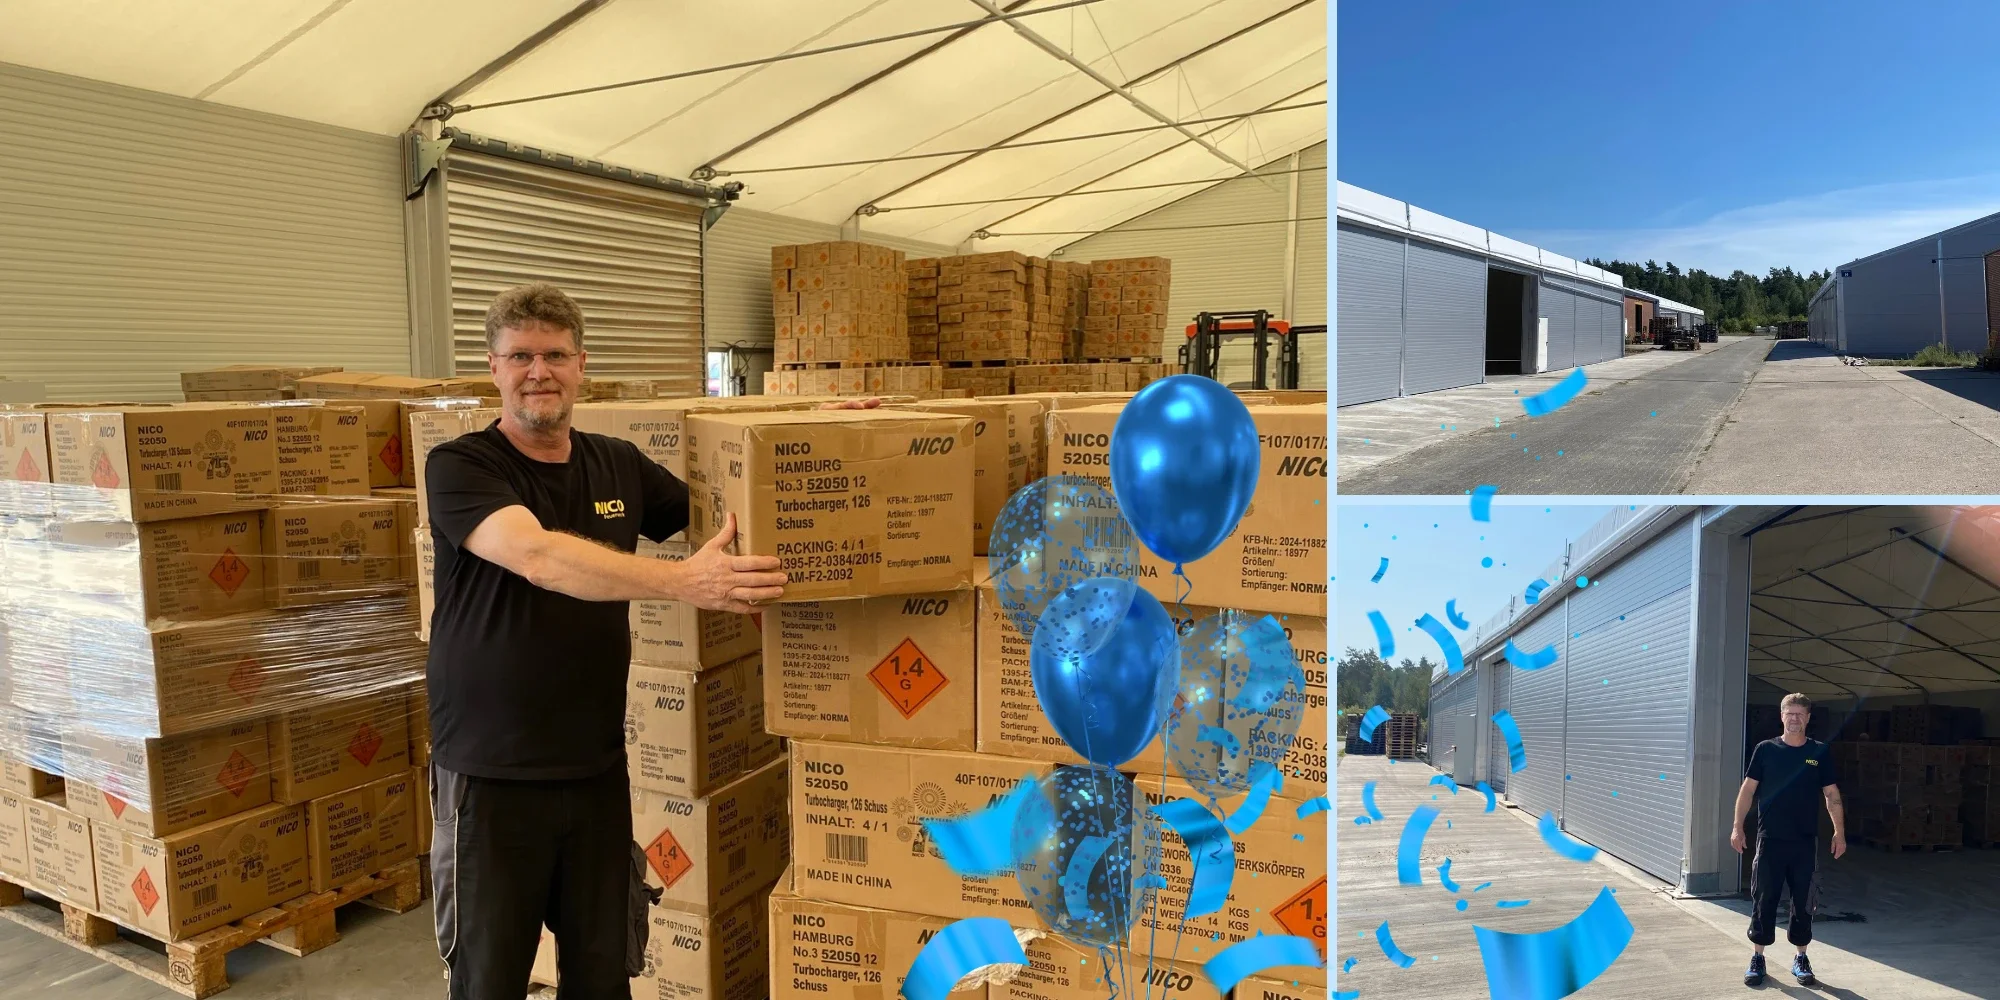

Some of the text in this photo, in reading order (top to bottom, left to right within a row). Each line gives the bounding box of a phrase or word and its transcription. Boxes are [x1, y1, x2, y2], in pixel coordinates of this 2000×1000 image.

[226, 420, 268, 428] 40F107/017/24
[337, 415, 358, 425] NICO
[21, 423, 37, 434] NICO
[99, 426, 116, 438] NICO
[138, 425, 164, 435] NICO
[277, 425, 308, 433] HAMBURG
[629, 422, 680, 432] 40F107/017/24
[138, 437, 167, 446] 52050
[244, 430, 268, 442] NICO
[648, 434, 679, 448] NICO
[1063, 433, 1110, 448] NICO
[775, 441, 812, 456] NICO
[907, 436, 954, 456] NICO
[141, 461, 183, 471] INHALT: 4
[729, 459, 742, 479] NICO
[775, 459, 842, 474] HAMBURG
[775, 475, 866, 492] No.3 52050 12
[144, 498, 198, 510] MADE IN CHINA
[775, 494, 870, 513] Turbocharger, 126
[886, 493, 954, 505] KFB-Nr.: 2024-1188277
[594, 499, 625, 515] NICO
[918, 508, 936, 518] 18977
[223, 522, 247, 535] NICO
[285, 518, 306, 527] NICO
[373, 519, 393, 530] NICO
[776, 516, 815, 531] Schuss
[886, 521, 912, 530] Größen/
[285, 528, 309, 536] 52050
[886, 532, 921, 541] Sortierung:
[776, 538, 864, 555] PACKING: 4 / 1
[1243, 535, 1278, 546] KFB-Nr.:
[1242, 546, 1309, 558] Artikelnr.: 18977
[220, 560, 239, 574] 1.4
[886, 555, 952, 571] Empfänger: NORMA
[1242, 556, 1275, 567] Größen/
[1059, 559, 1158, 578] MADE IN CHINA
[1241, 567, 1288, 581] Sortierung:
[787, 569, 853, 584] AM-F2-2092
[1241, 580, 1288, 593] Empfänger:
[902, 598, 949, 616] NICO
[781, 610, 798, 619] No.3
[799, 611, 823, 619] 52050
[993, 612, 999, 621] 9
[781, 621, 837, 632] Turbocharger, 126
[159, 633, 182, 644] NICO
[781, 631, 804, 640] Schuss
[665, 640, 684, 648] NORMA
[782, 642, 821, 651] PACKING:
[1001, 646, 1027, 656] Schuss
[783, 652, 850, 663] 1395-F2-0384/2015
[783, 661, 831, 670] BAM-F2-2092
[890, 656, 925, 678] 1.4
[783, 671, 809, 679] KFB-Nr.:
[635, 681, 686, 696] 40F107/017/24
[706, 680, 721, 692] NICO
[783, 682, 832, 692] Artikelnr.: 18977
[900, 679, 911, 691] G
[783, 691, 808, 700] Größen/
[1001, 687, 1030, 697] KFB-Nr.:
[655, 696, 685, 711] NICO
[783, 701, 818, 711] Sortierung:
[904, 699, 909, 708] 1
[1001, 701, 1035, 711] Artikelnr.:
[784, 711, 850, 723] Empfänger: NORMA
[1001, 711, 1029, 721] Größen/
[1001, 721, 1040, 733] Sortierung:
[1001, 733, 1041, 744] Empfänger:
[127, 753, 143, 766] NICO
[805, 760, 845, 777] NICO
[665, 774, 686, 783] NORMA
[386, 782, 405, 797] NICO
[805, 777, 849, 793] 52050
[3, 796, 17, 809] NICO
[328, 802, 344, 813] NICO
[664, 800, 694, 816] NICO
[717, 798, 736, 813] NICO
[805, 793, 888, 814] Turbocharger, 126 Schuss
[29, 807, 41, 816] NICO
[328, 806, 359, 823] HAMBURG
[68, 820, 82, 834] NICO
[276, 820, 299, 837] NICO
[806, 813, 888, 833] INHALT: 4 1
[141, 844, 158, 857] NICO
[175, 844, 200, 859] NICO
[656, 842, 678, 861] 1.4
[177, 854, 204, 869] 52050
[662, 860, 670, 869] G
[1160, 863, 1182, 875] 0336
[179, 876, 209, 892] INHALT:
[807, 868, 892, 889] MADE IN CHINA
[138, 878, 151, 893] 1.4
[962, 884, 1000, 897] Sortierung:
[962, 894, 1034, 909] Empfänger: NORMA
[182, 903, 232, 926] MADE CHINA
[1229, 908, 1250, 919] KGS
[653, 917, 702, 937] 40F107/017/24
[793, 914, 826, 928] NICO
[1141, 919, 1165, 931] SIZE:
[1208, 918, 1249, 932] 14 KGS
[671, 934, 702, 952] NICO
[793, 930, 854, 946] HAMBURG
[793, 946, 877, 965] No.3 52050 12
[793, 963, 881, 983] Turbocharger, 126
[1058, 966, 1067, 975] 12
[793, 978, 828, 992] Schuss
[1057, 977, 1070, 987] 126
[1141, 967, 1194, 992] NICO
